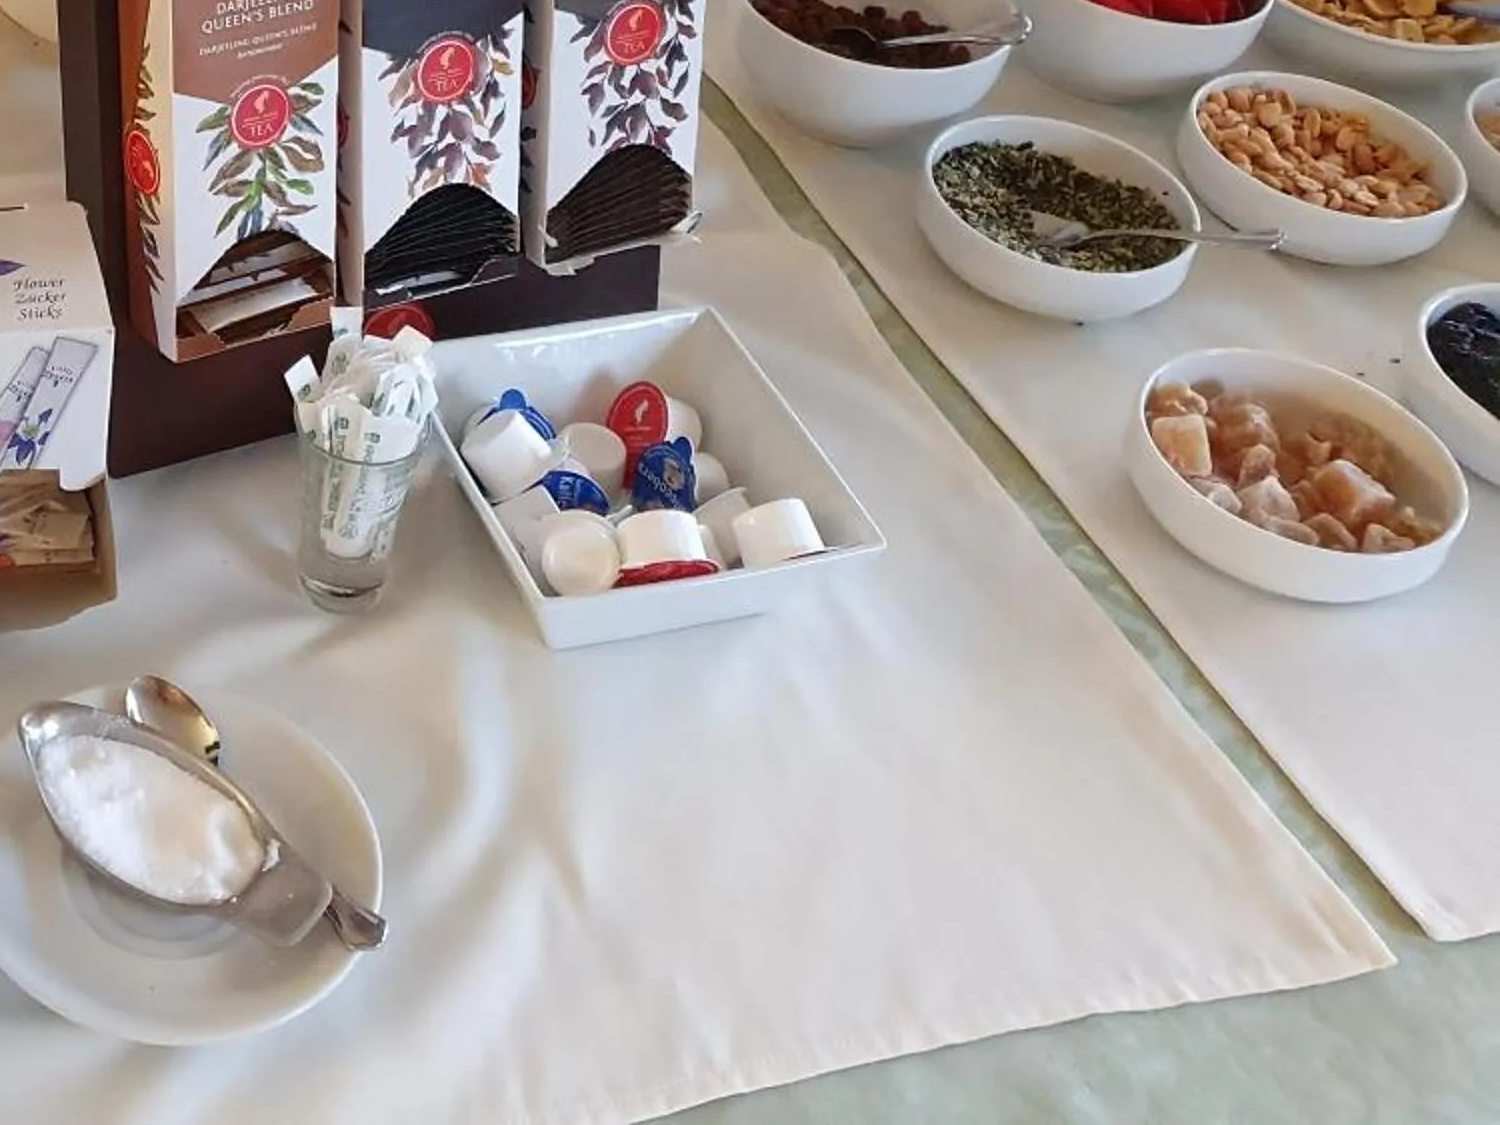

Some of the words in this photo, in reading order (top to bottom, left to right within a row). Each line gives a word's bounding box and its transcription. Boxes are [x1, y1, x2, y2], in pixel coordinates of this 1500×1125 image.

[201, 8, 265, 35] QUEEN'S
[249, 121, 274, 137] TEA
[14, 290, 66, 305] Zucker
[16, 305, 63, 322] Sticks
